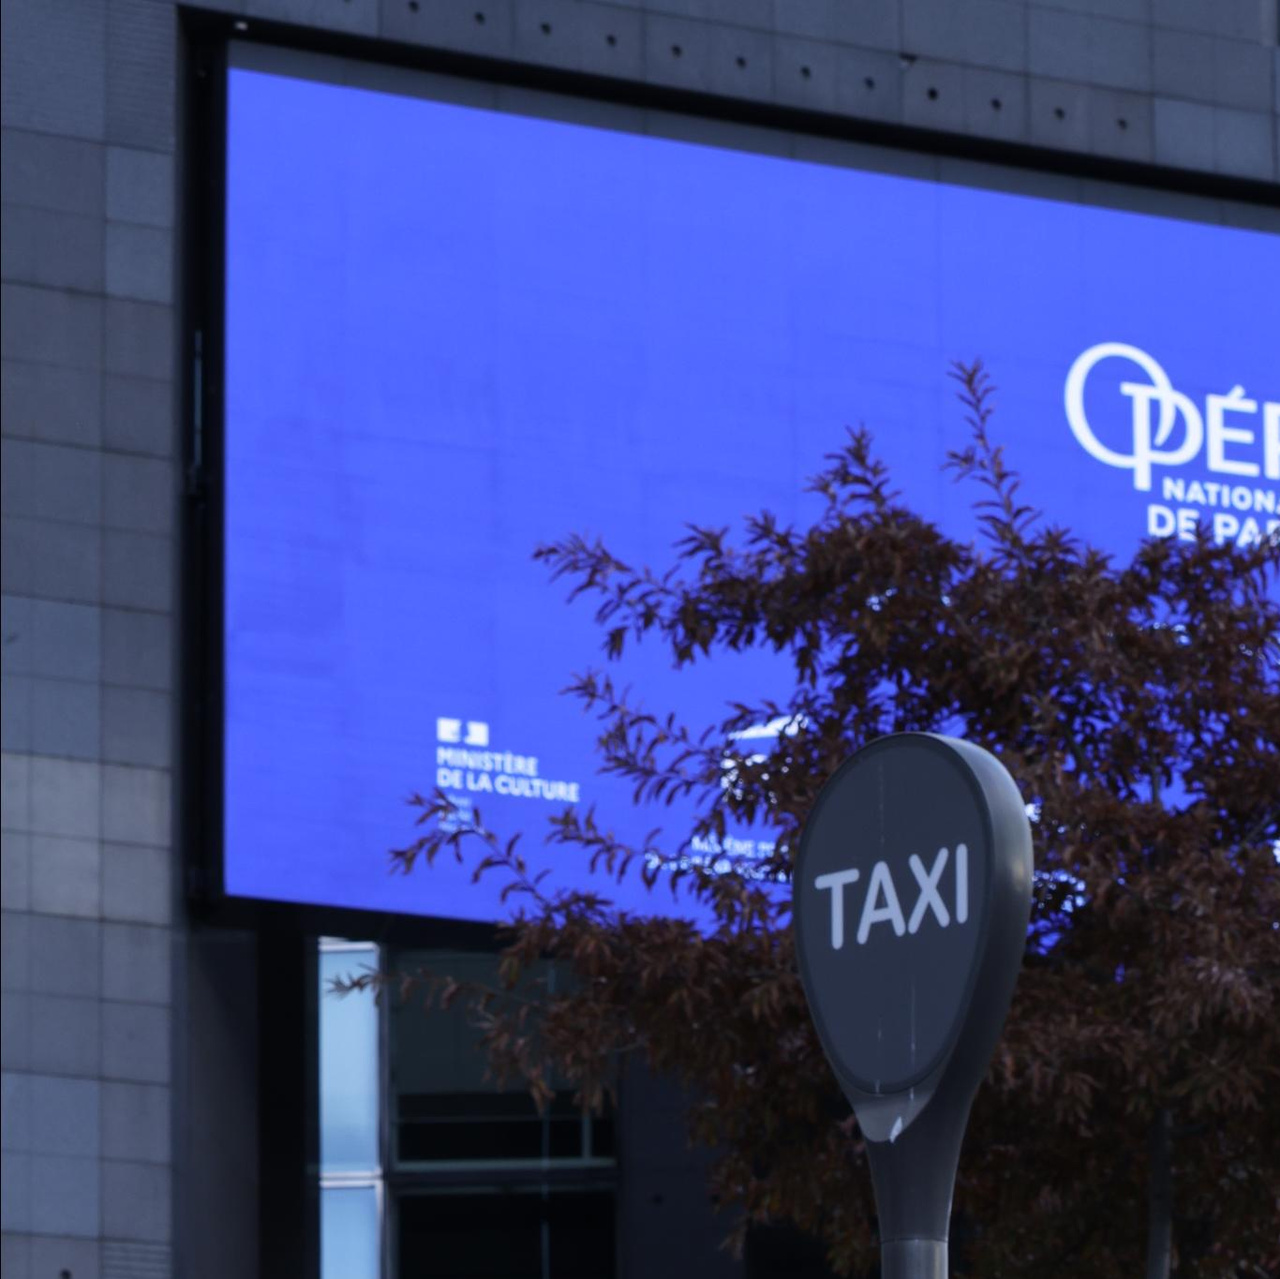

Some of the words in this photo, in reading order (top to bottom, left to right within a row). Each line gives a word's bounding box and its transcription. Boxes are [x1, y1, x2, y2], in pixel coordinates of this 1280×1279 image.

[1147, 504, 1200, 542] DE
[436, 746, 539, 777] MINISTÈRE
[436, 766, 464, 789] DE
[466, 771, 494, 792] LA
[494, 774, 581, 803] CULTURE
[814, 843, 968, 950] TAXI
